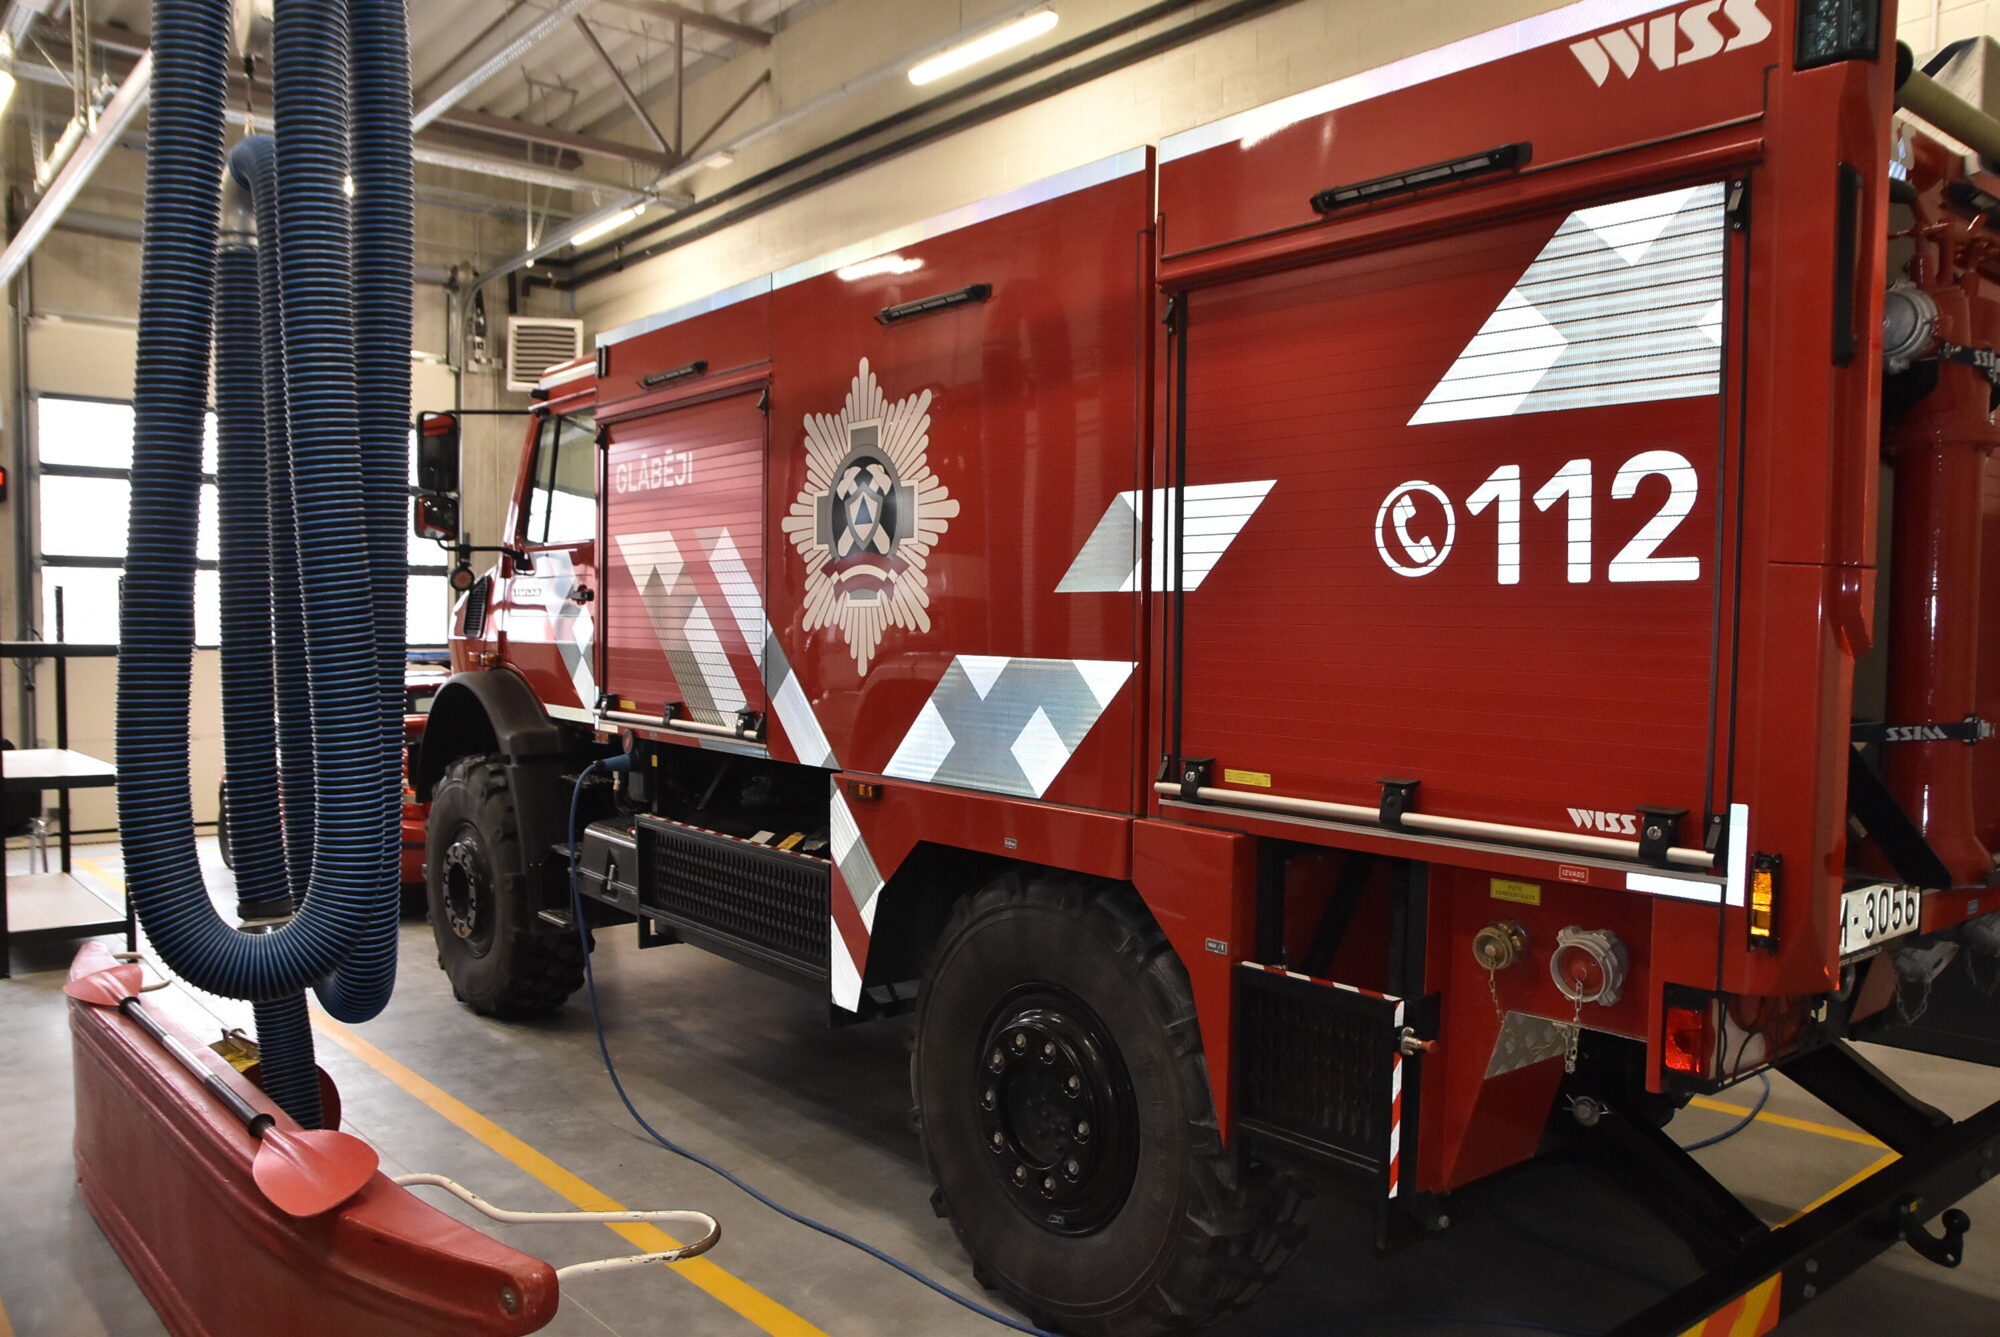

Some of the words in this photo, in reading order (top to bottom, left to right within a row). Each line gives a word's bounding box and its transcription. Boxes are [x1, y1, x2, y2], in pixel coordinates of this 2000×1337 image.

[1568, 0, 1773, 89] WISS
[615, 448, 694, 494] GLĀBĒJI
[1465, 449, 1701, 586] 112
[1885, 725, 1948, 741] WISS
[1566, 807, 1637, 835] WISS
